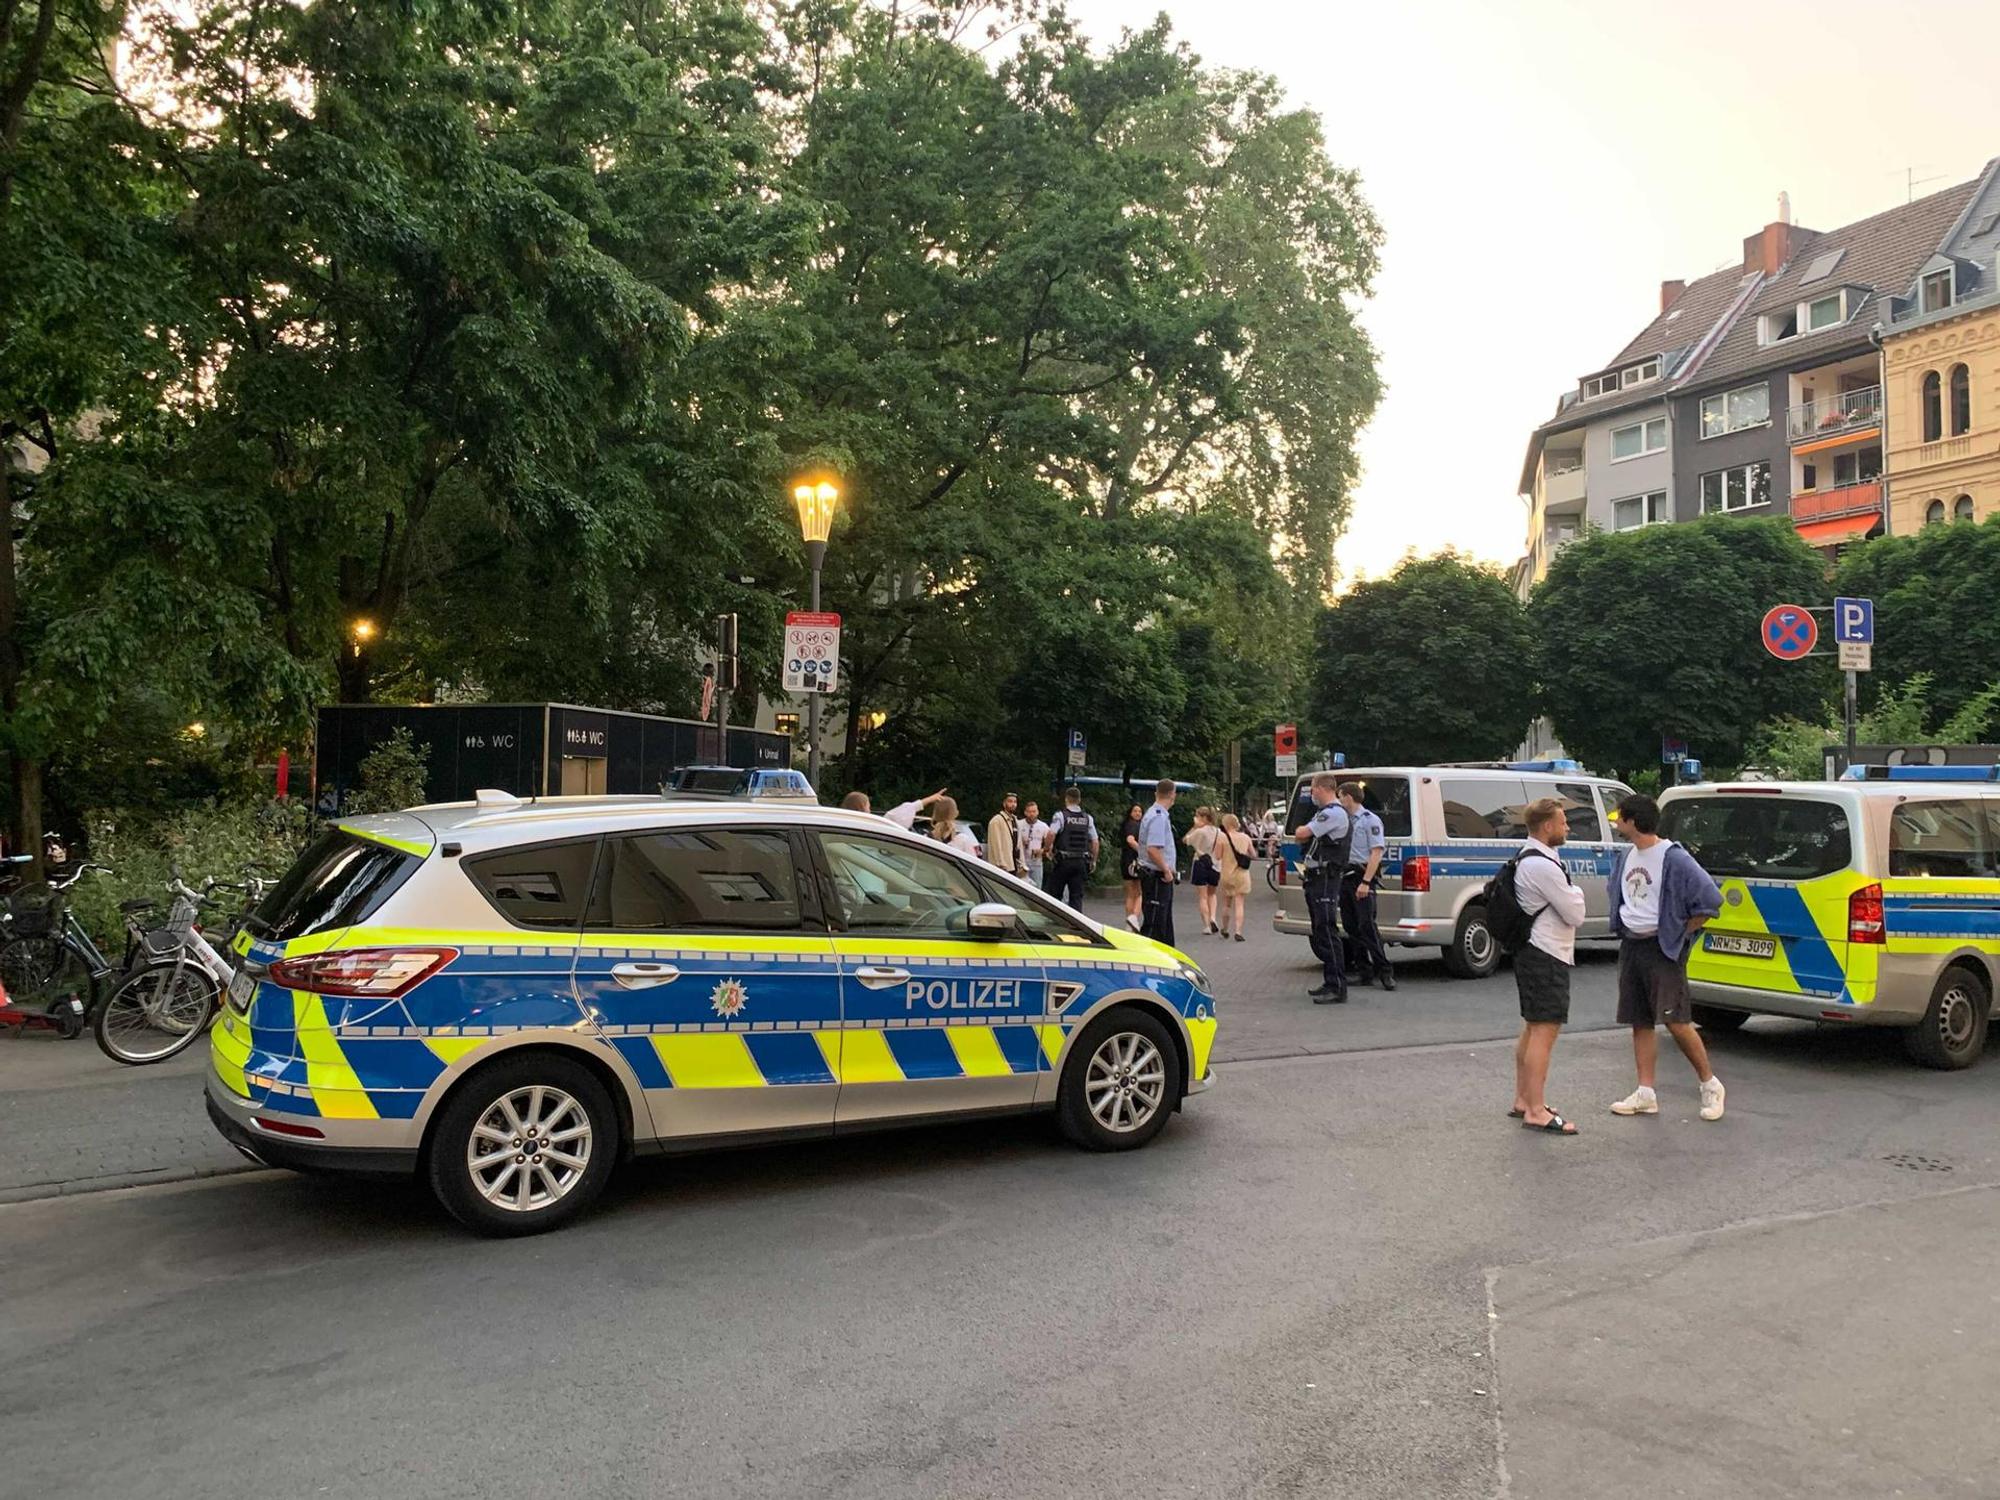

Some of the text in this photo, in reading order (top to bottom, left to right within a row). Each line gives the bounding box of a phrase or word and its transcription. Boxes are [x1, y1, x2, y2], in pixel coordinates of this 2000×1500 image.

[1844, 604, 1864, 638] P
[492, 735, 514, 748] WC
[589, 732, 604, 746] WC
[1073, 731, 1083, 747] P
[1561, 860, 1598, 875] OLIZEI
[1712, 934, 1730, 949] NRW
[1747, 941, 1773, 954] 3099
[906, 981, 1021, 1010] POLIZEI
